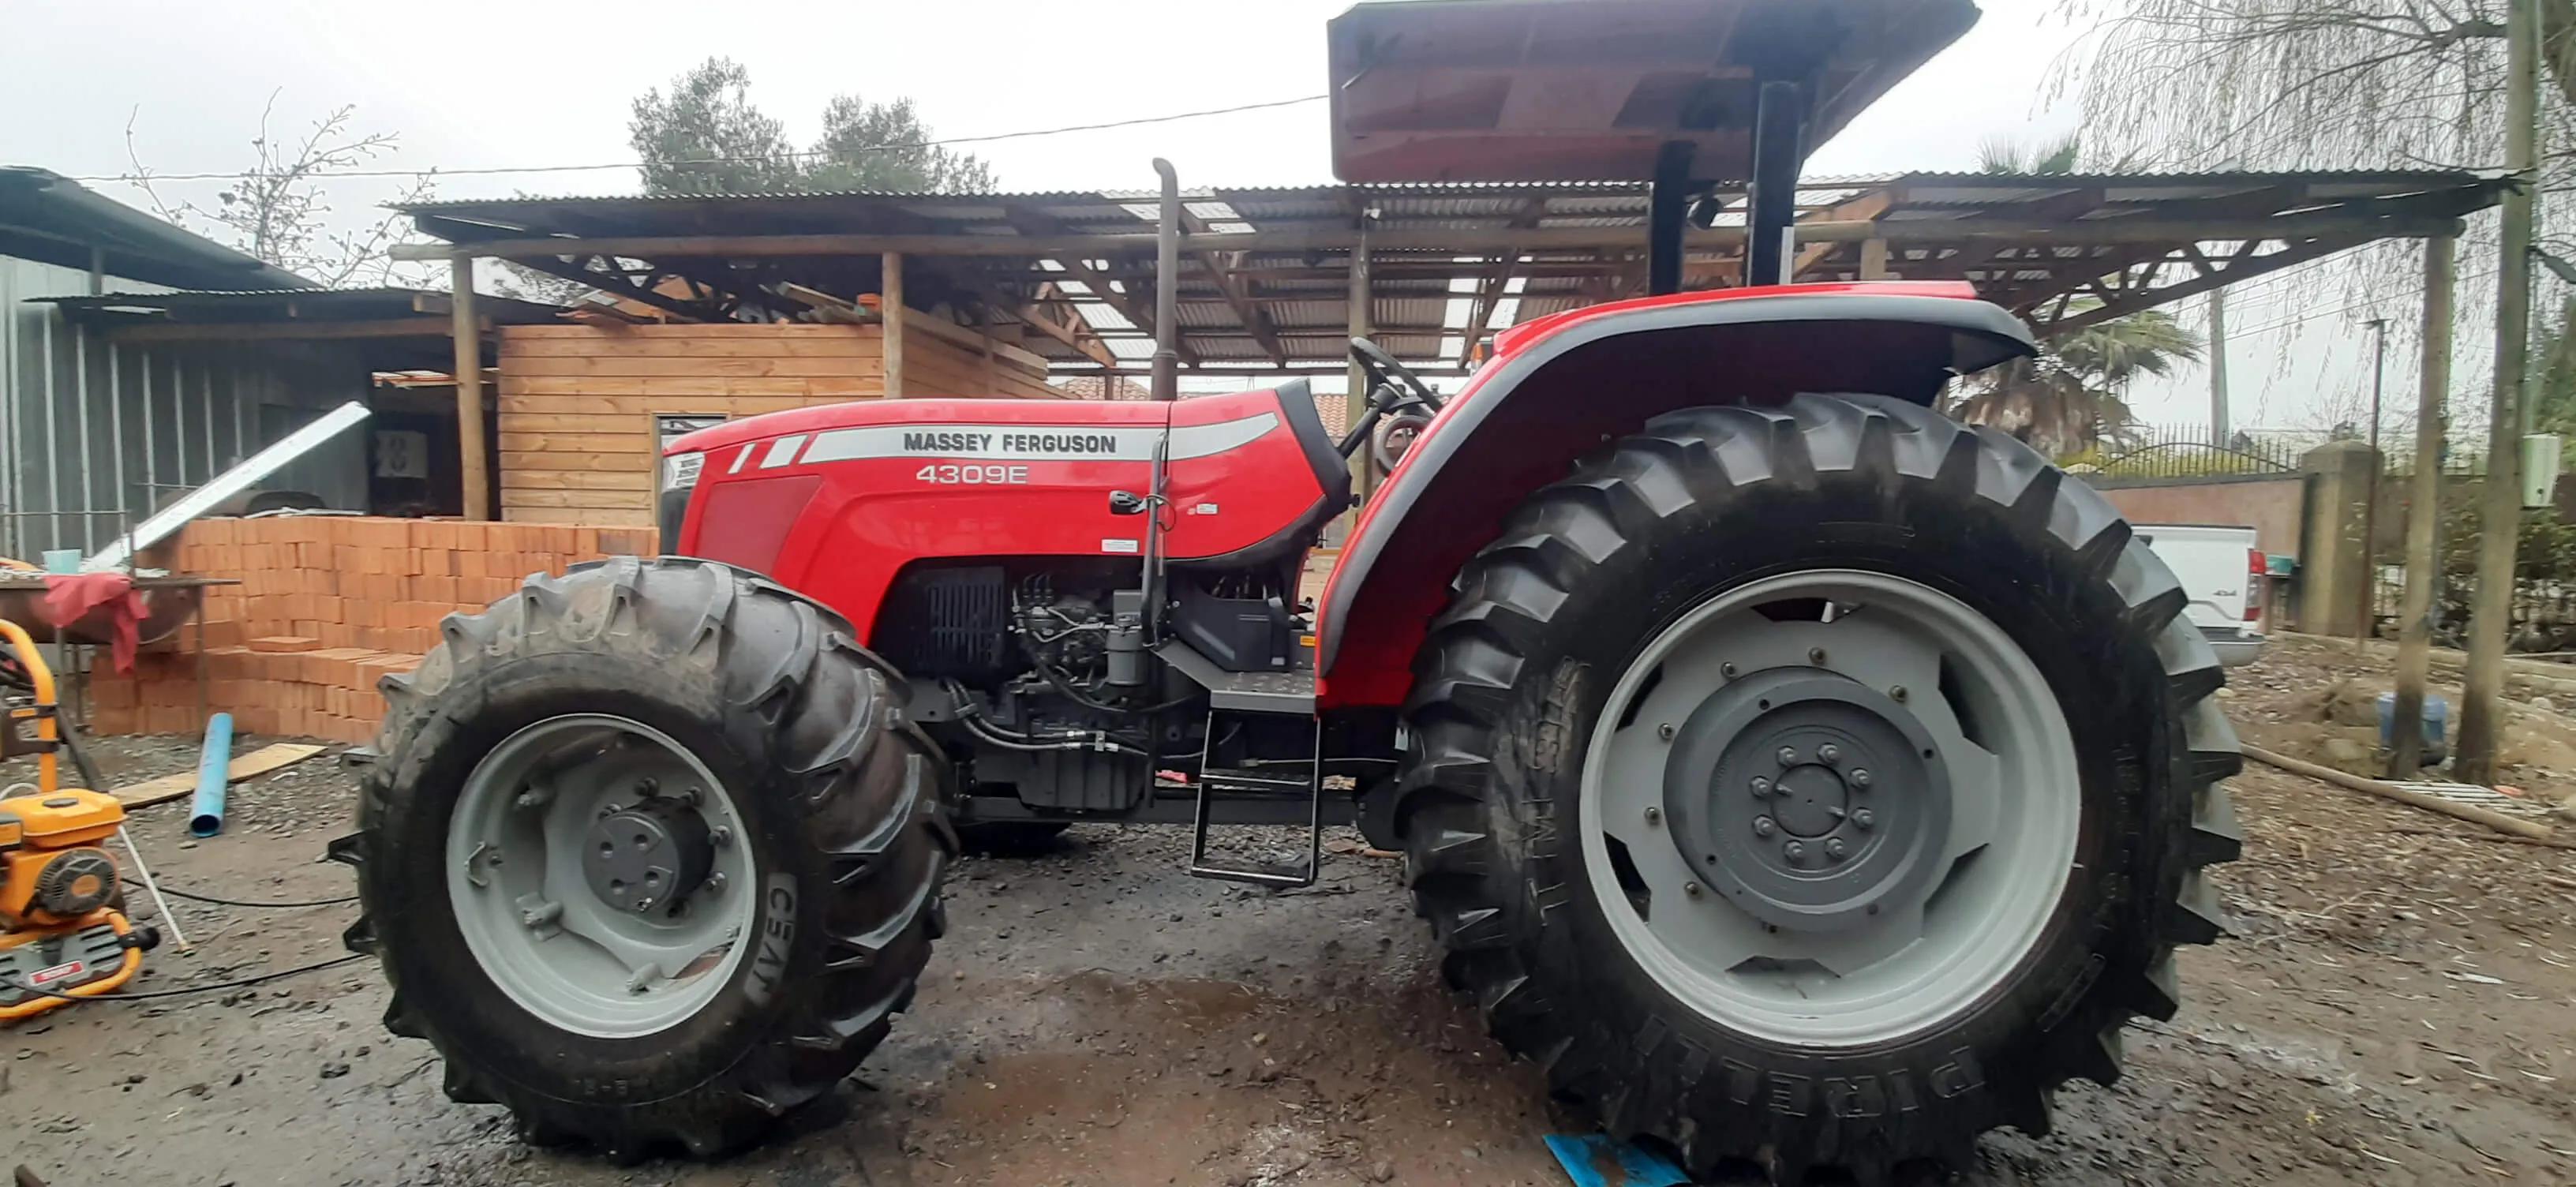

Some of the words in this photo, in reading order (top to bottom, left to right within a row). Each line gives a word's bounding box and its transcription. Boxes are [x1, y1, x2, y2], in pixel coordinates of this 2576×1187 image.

[904, 432, 992, 451] MASSEY
[1002, 434, 1116, 453] FERGUSON
[915, 464, 1028, 485] 4309E
[753, 887, 794, 993] CEAT
[1633, 1015, 1986, 1118] PIRELLI
